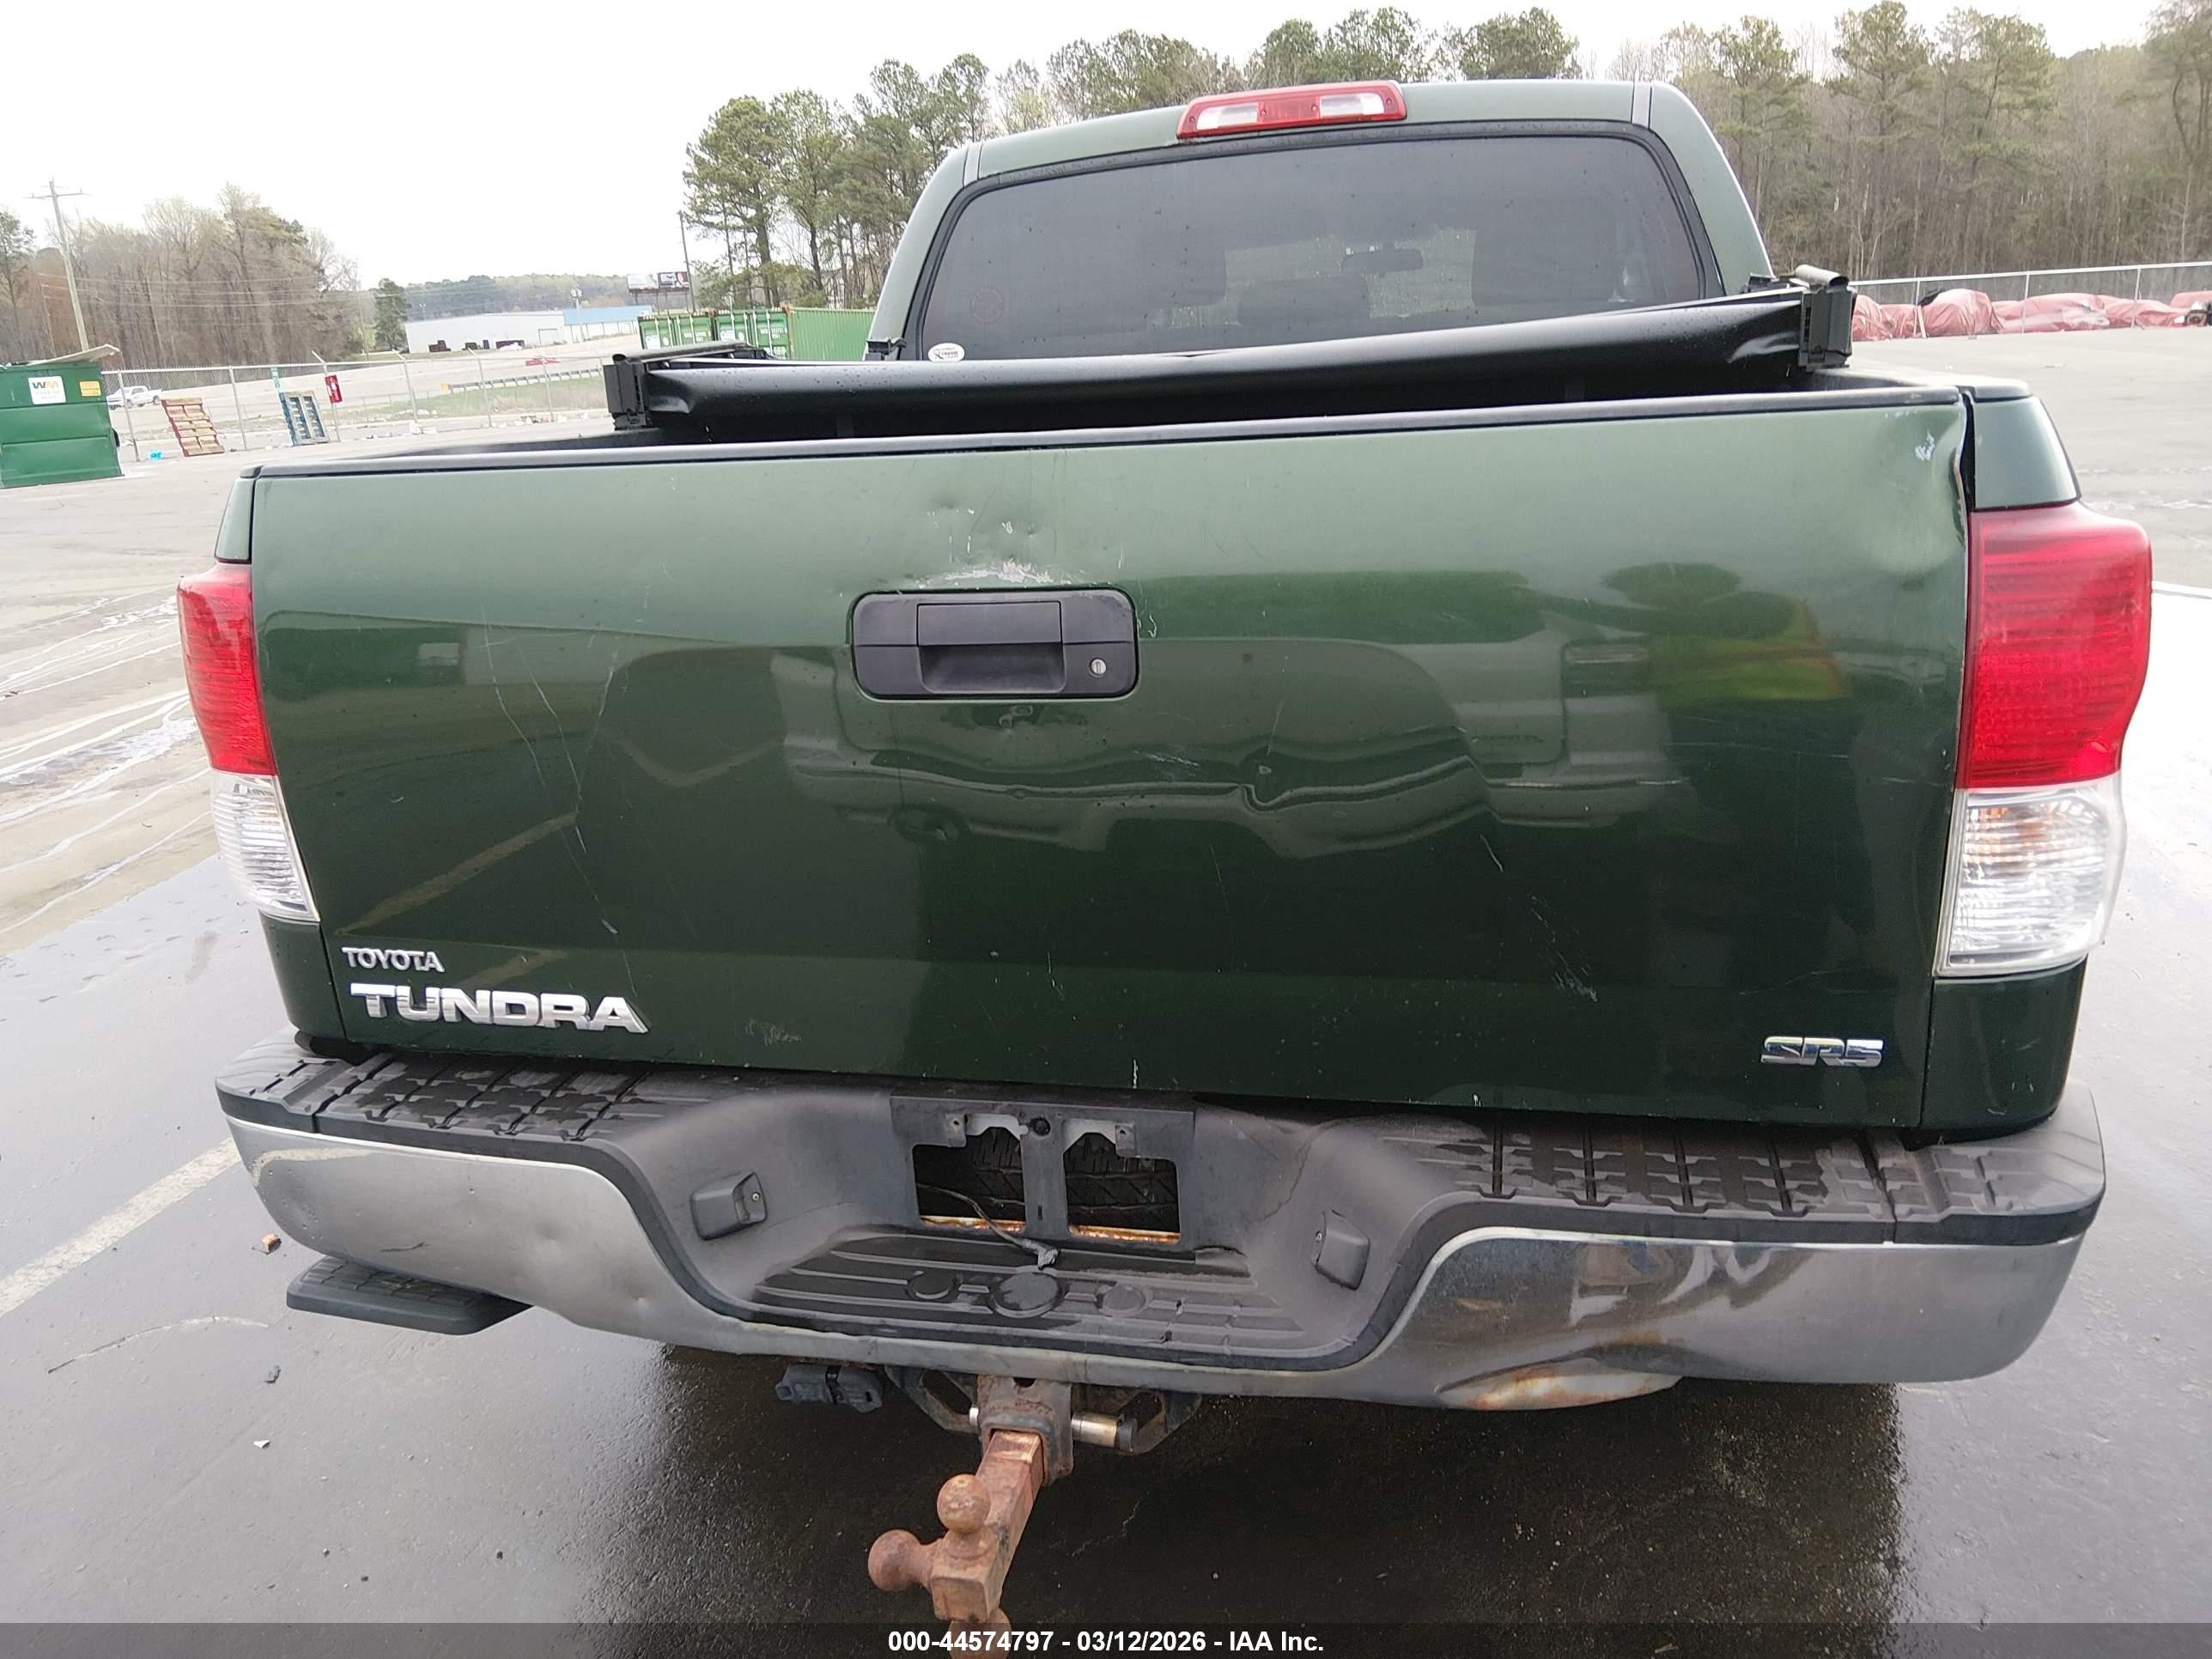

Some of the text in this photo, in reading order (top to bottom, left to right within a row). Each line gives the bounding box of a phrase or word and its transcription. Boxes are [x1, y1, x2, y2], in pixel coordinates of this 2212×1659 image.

[342, 946, 445, 972] TOYOTA
[350, 982, 649, 1034] TUNDRA
[1760, 1036, 1884, 1067] SR5
